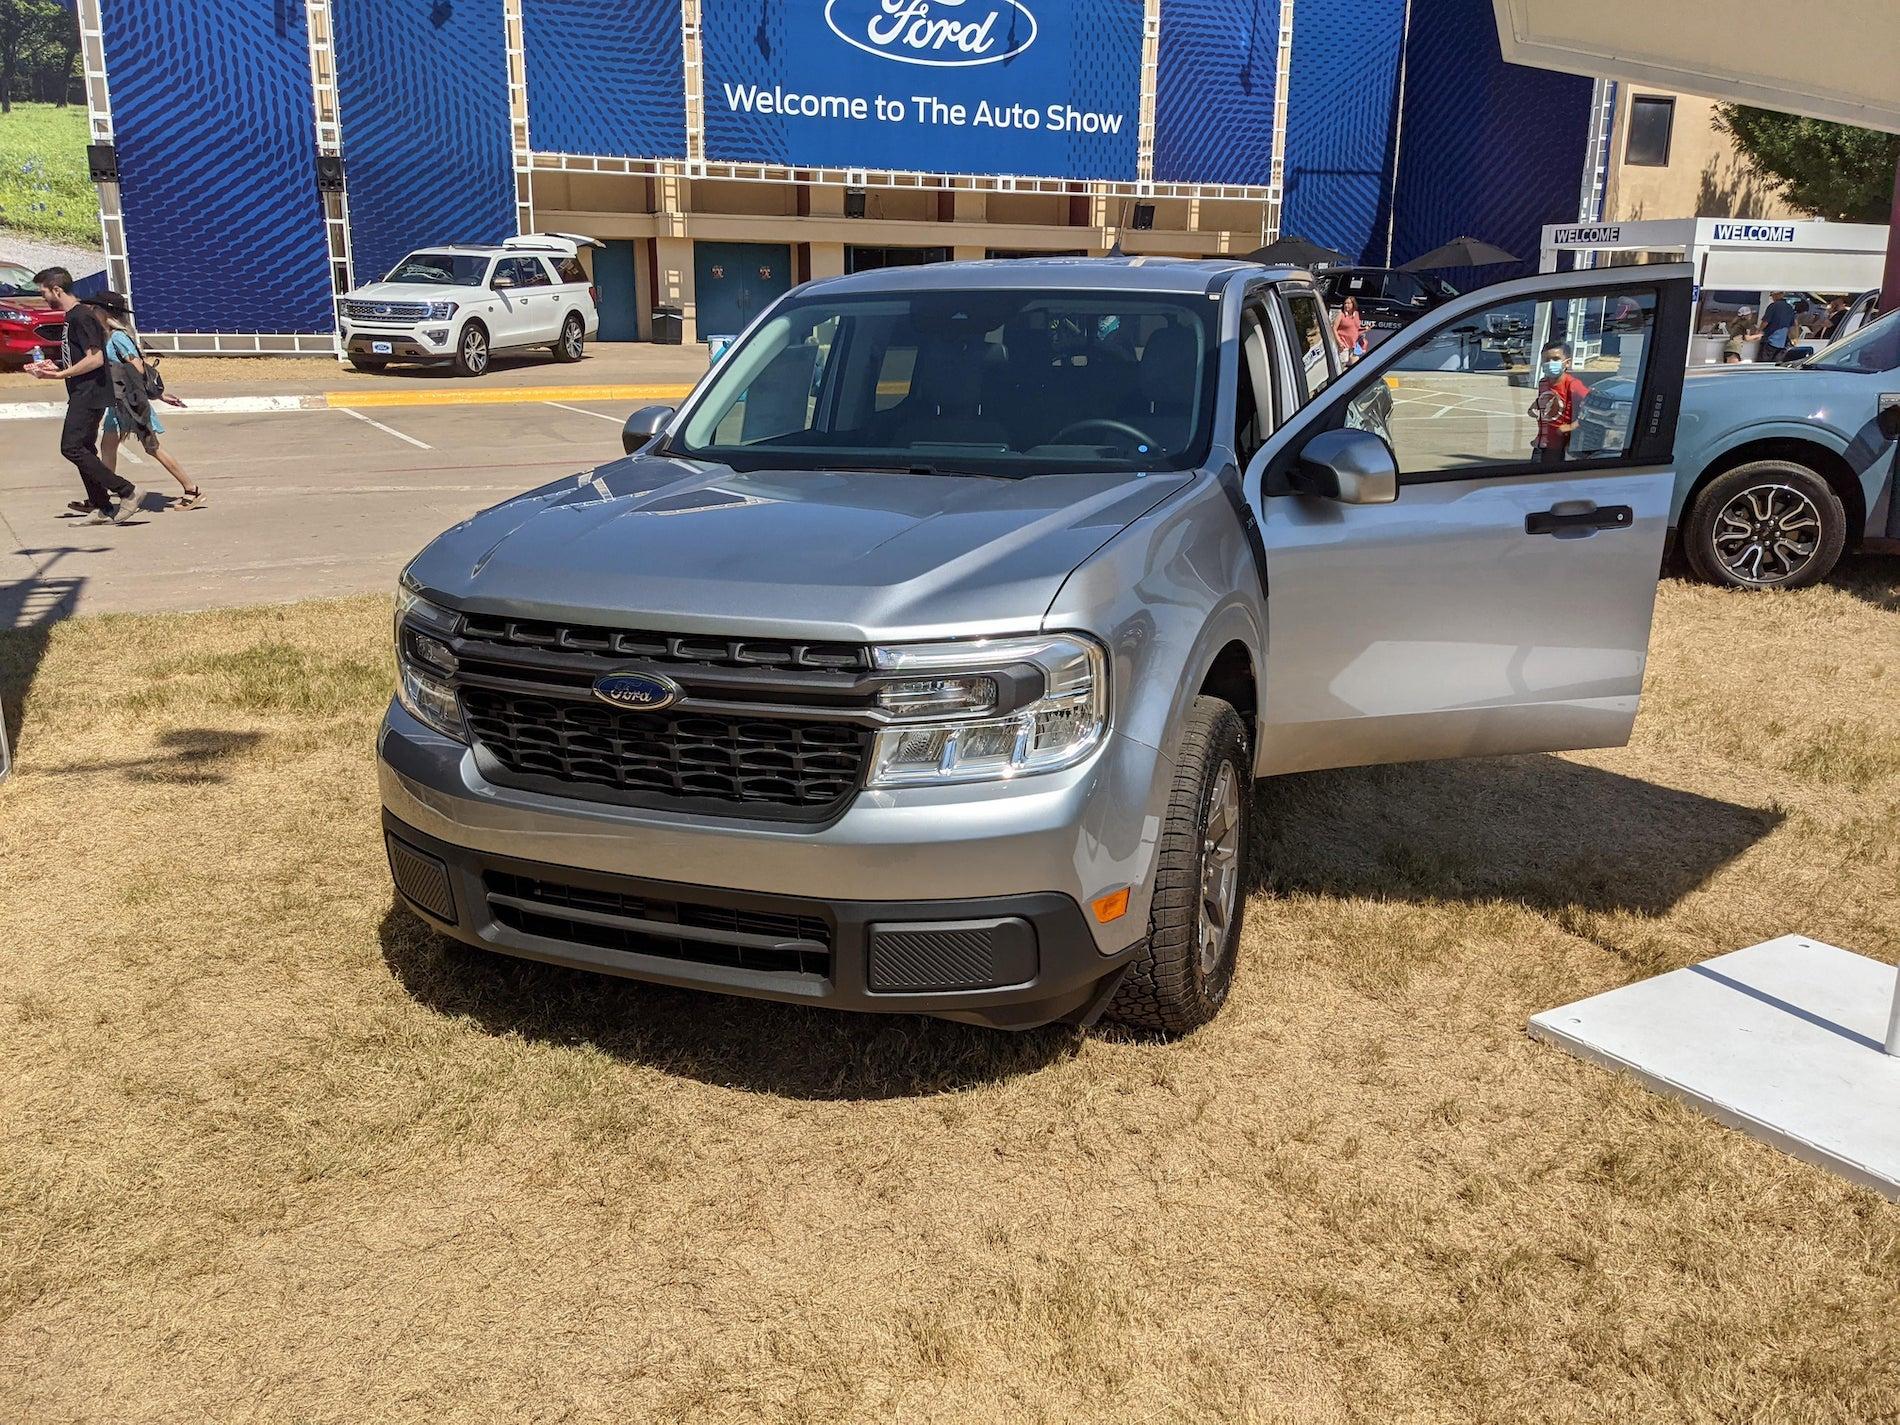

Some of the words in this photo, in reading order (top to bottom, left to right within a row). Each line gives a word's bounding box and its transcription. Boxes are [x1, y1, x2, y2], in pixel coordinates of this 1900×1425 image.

[867, 0, 999, 54] Ford
[723, 83, 868, 120] Welcome
[874, 94, 905, 122] to
[911, 96, 967, 126] The
[972, 100, 1040, 130] Auto
[1045, 104, 1123, 134] Show
[1556, 227, 1619, 242] WELCOME
[1717, 225, 1793, 242] WELCOME
[610, 682, 653, 702] Ford
